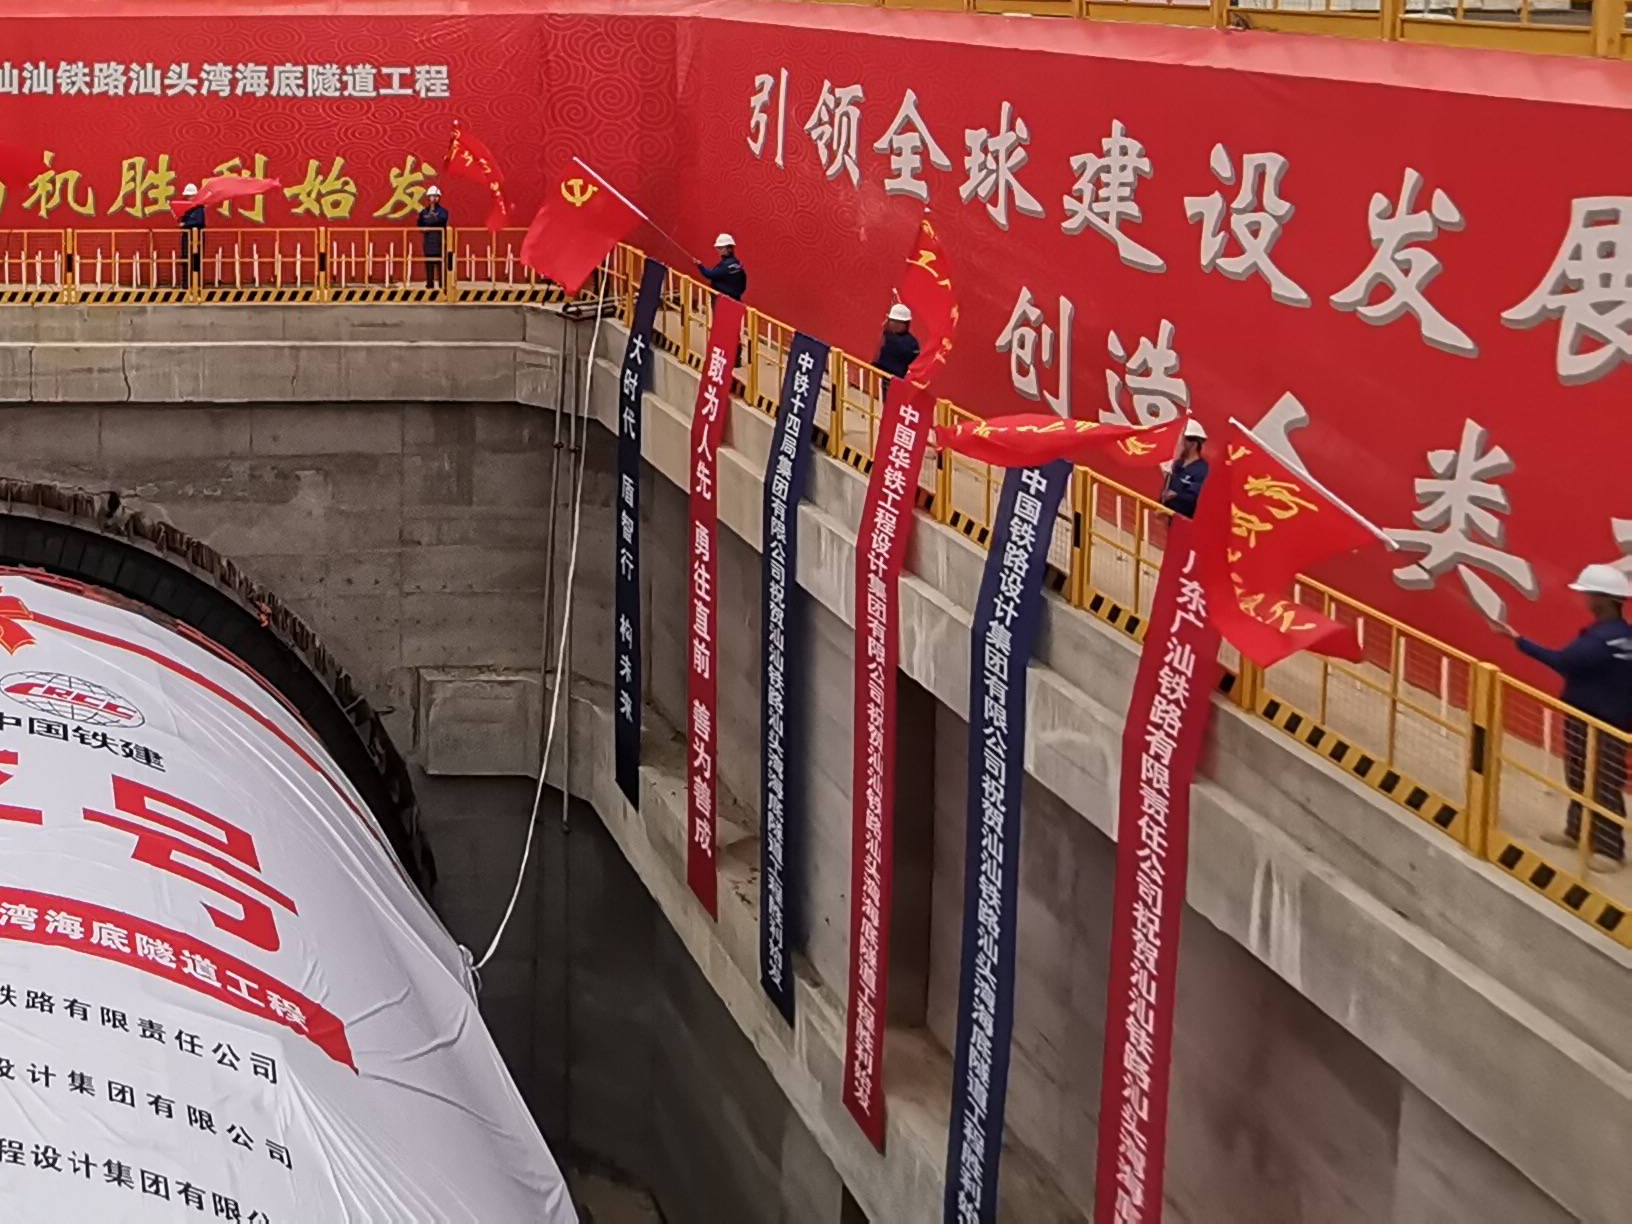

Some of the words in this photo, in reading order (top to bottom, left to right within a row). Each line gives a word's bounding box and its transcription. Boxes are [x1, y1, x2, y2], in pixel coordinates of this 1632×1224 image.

[622, 334, 645, 439] 大时代
[696, 346, 728, 500] 敢为人先
[693, 520, 711, 679] 勇往直前
